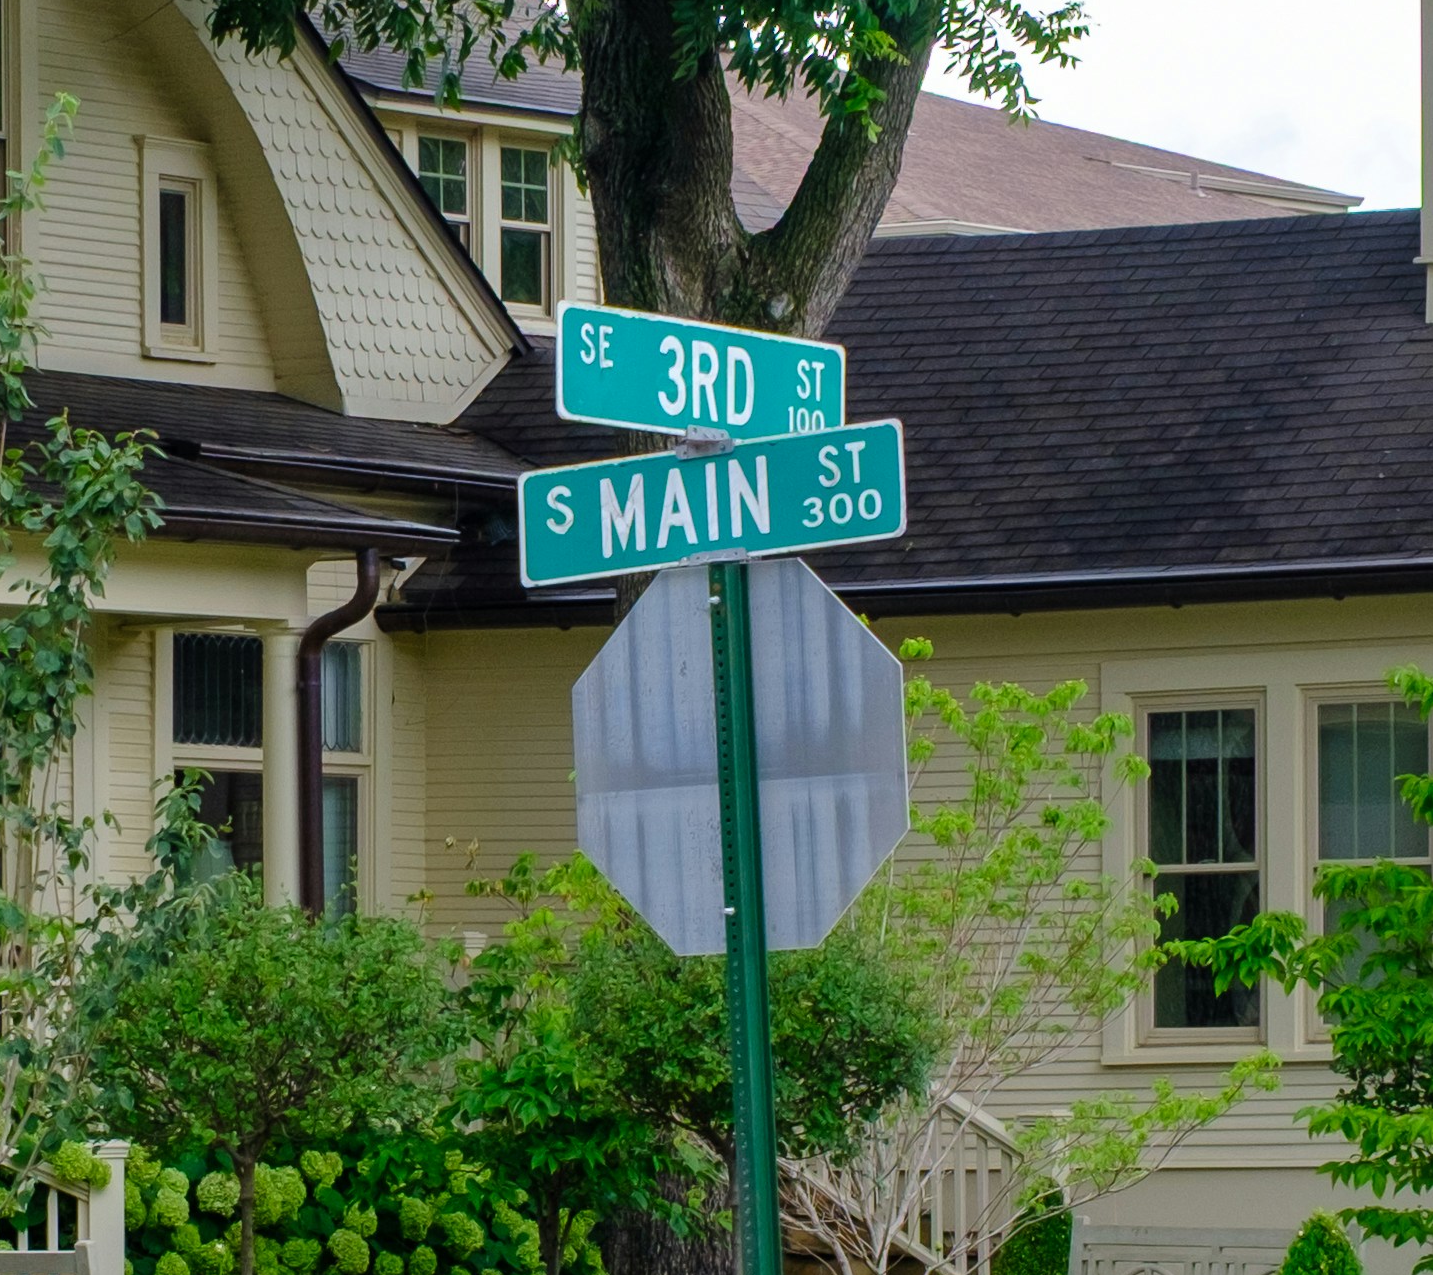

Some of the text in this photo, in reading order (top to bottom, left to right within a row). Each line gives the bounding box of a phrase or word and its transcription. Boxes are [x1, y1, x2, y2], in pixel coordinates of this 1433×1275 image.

[580, 322, 825, 426] SE 3RD ST
[787, 406, 825, 434] 100
[546, 440, 866, 559] S MAIN ST
[802, 488, 883, 528] 300
